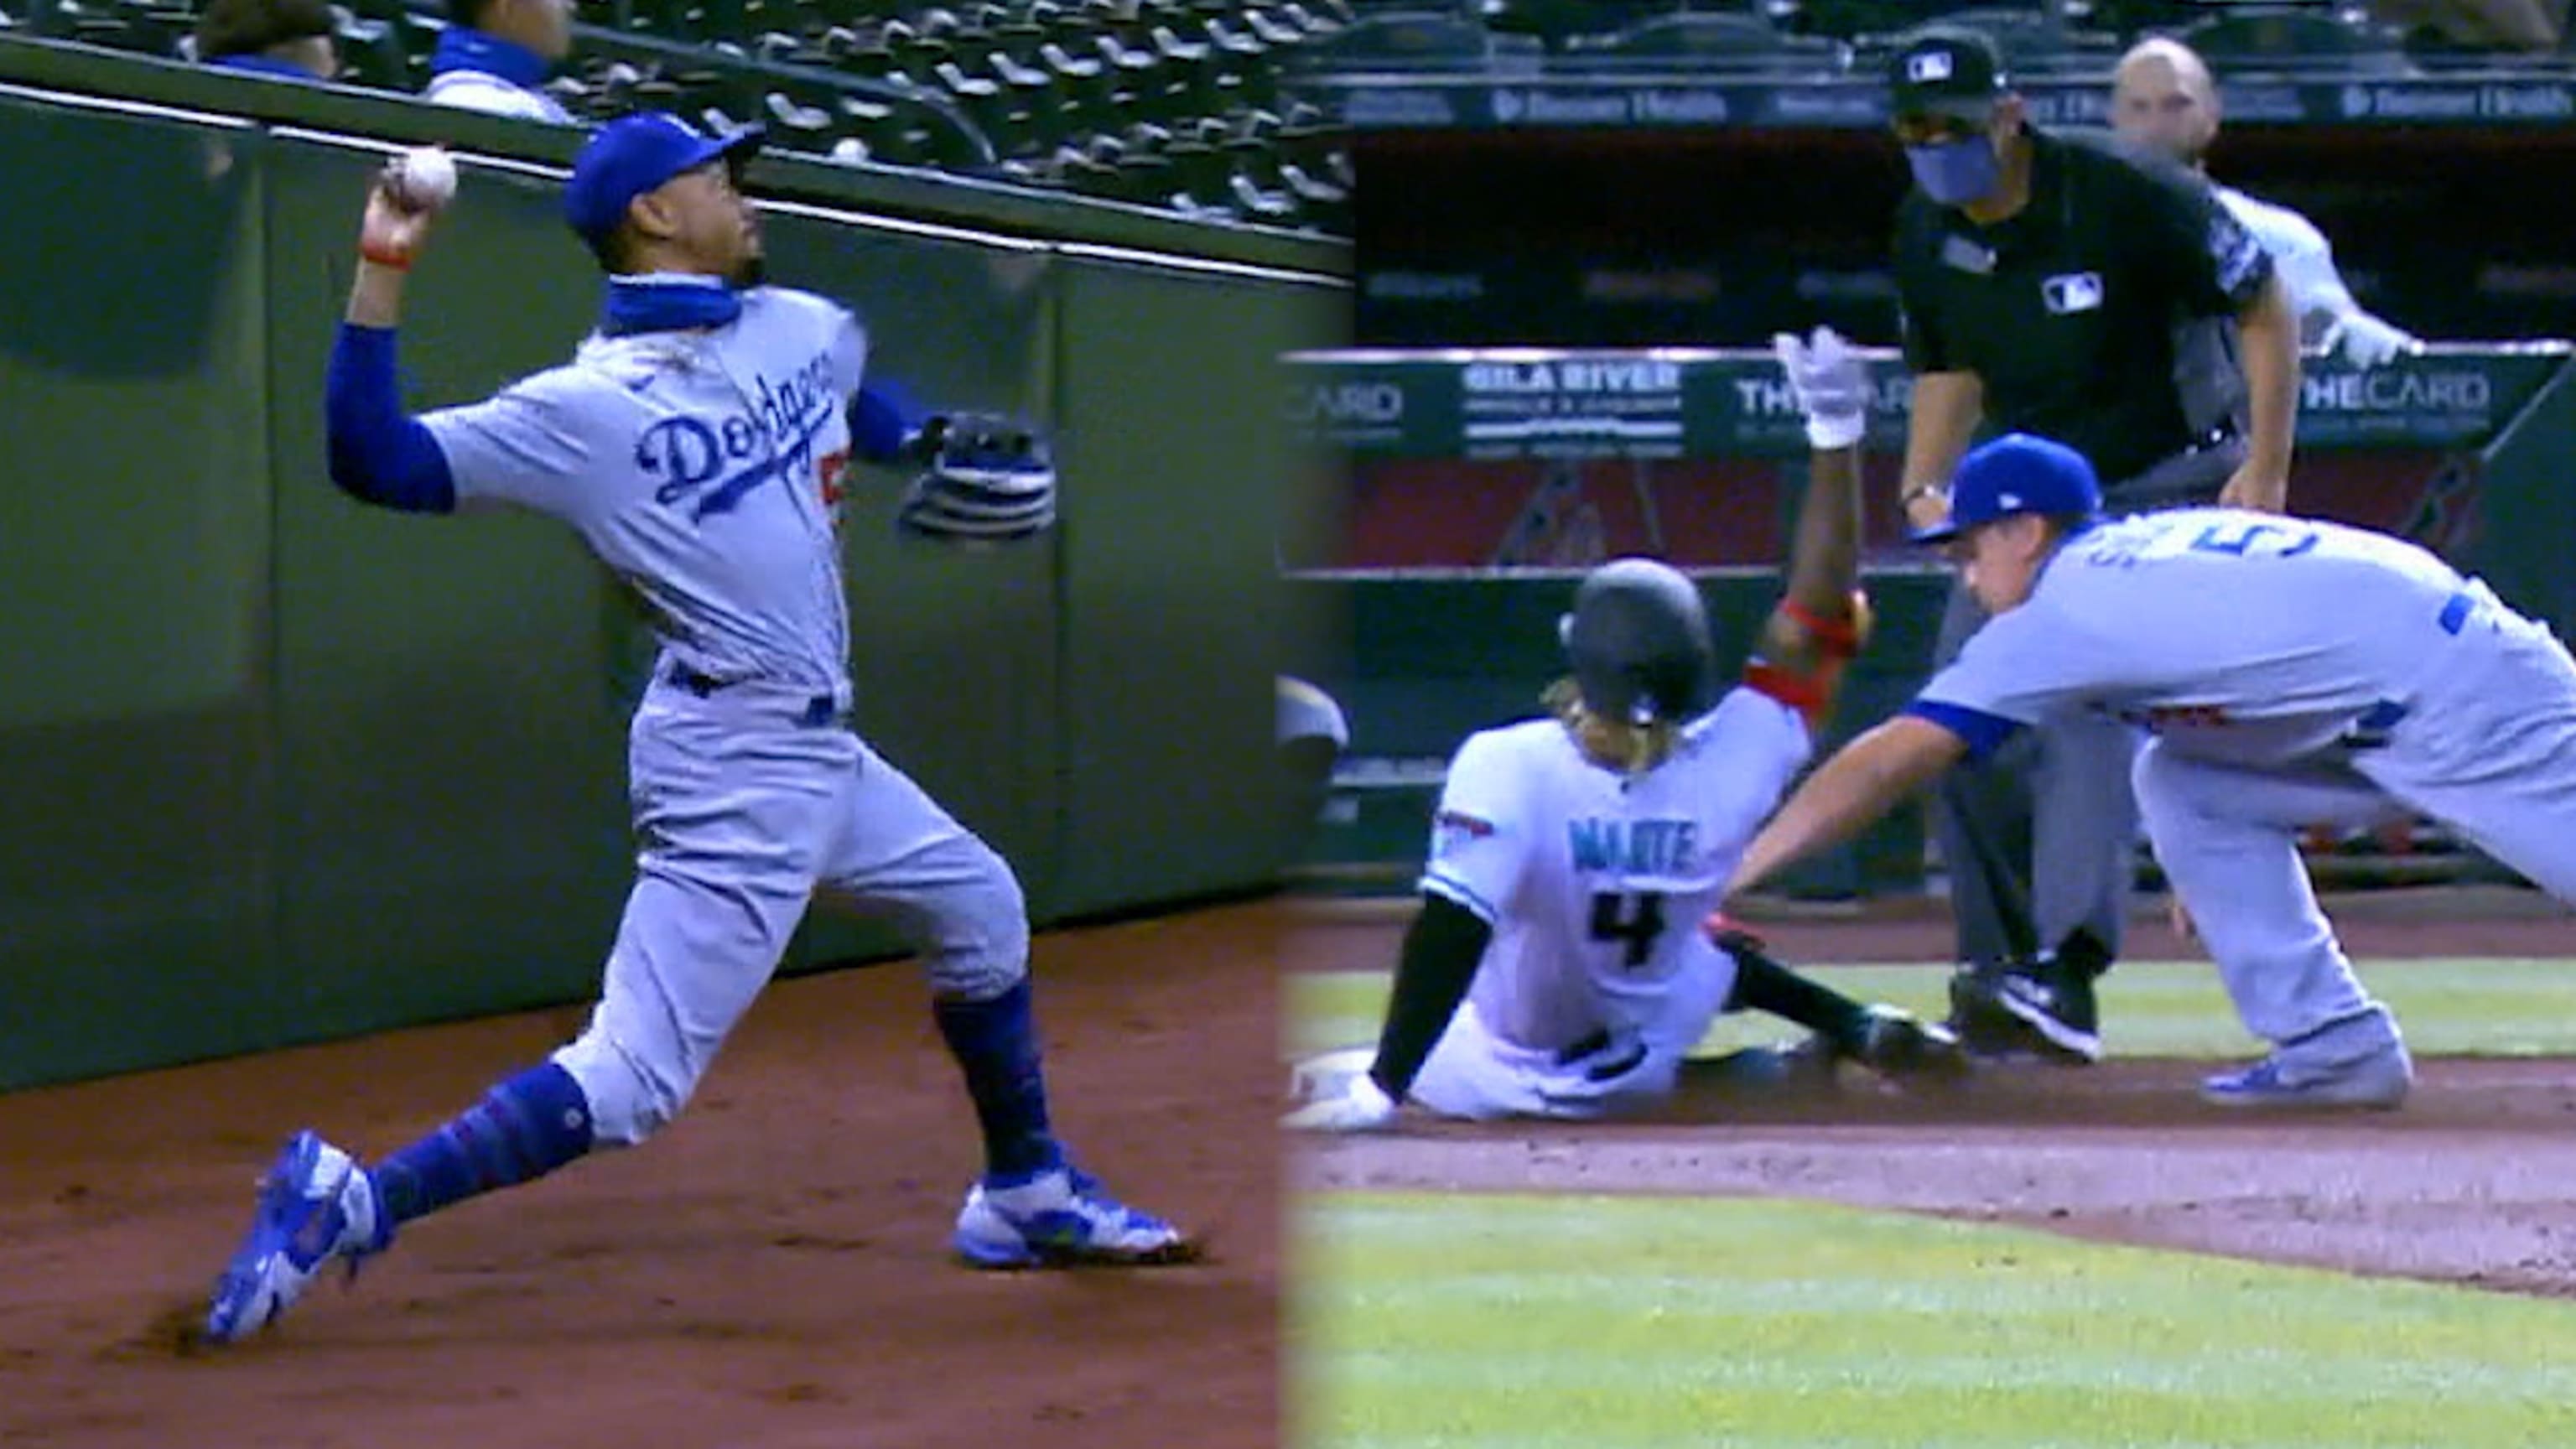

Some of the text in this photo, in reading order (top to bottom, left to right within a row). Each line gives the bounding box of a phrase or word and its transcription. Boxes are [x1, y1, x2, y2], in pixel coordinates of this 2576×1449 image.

[1464, 363, 1680, 391] GILA RIVER
[2301, 373, 2490, 410] HECARD
[1587, 891, 1666, 971] 4
